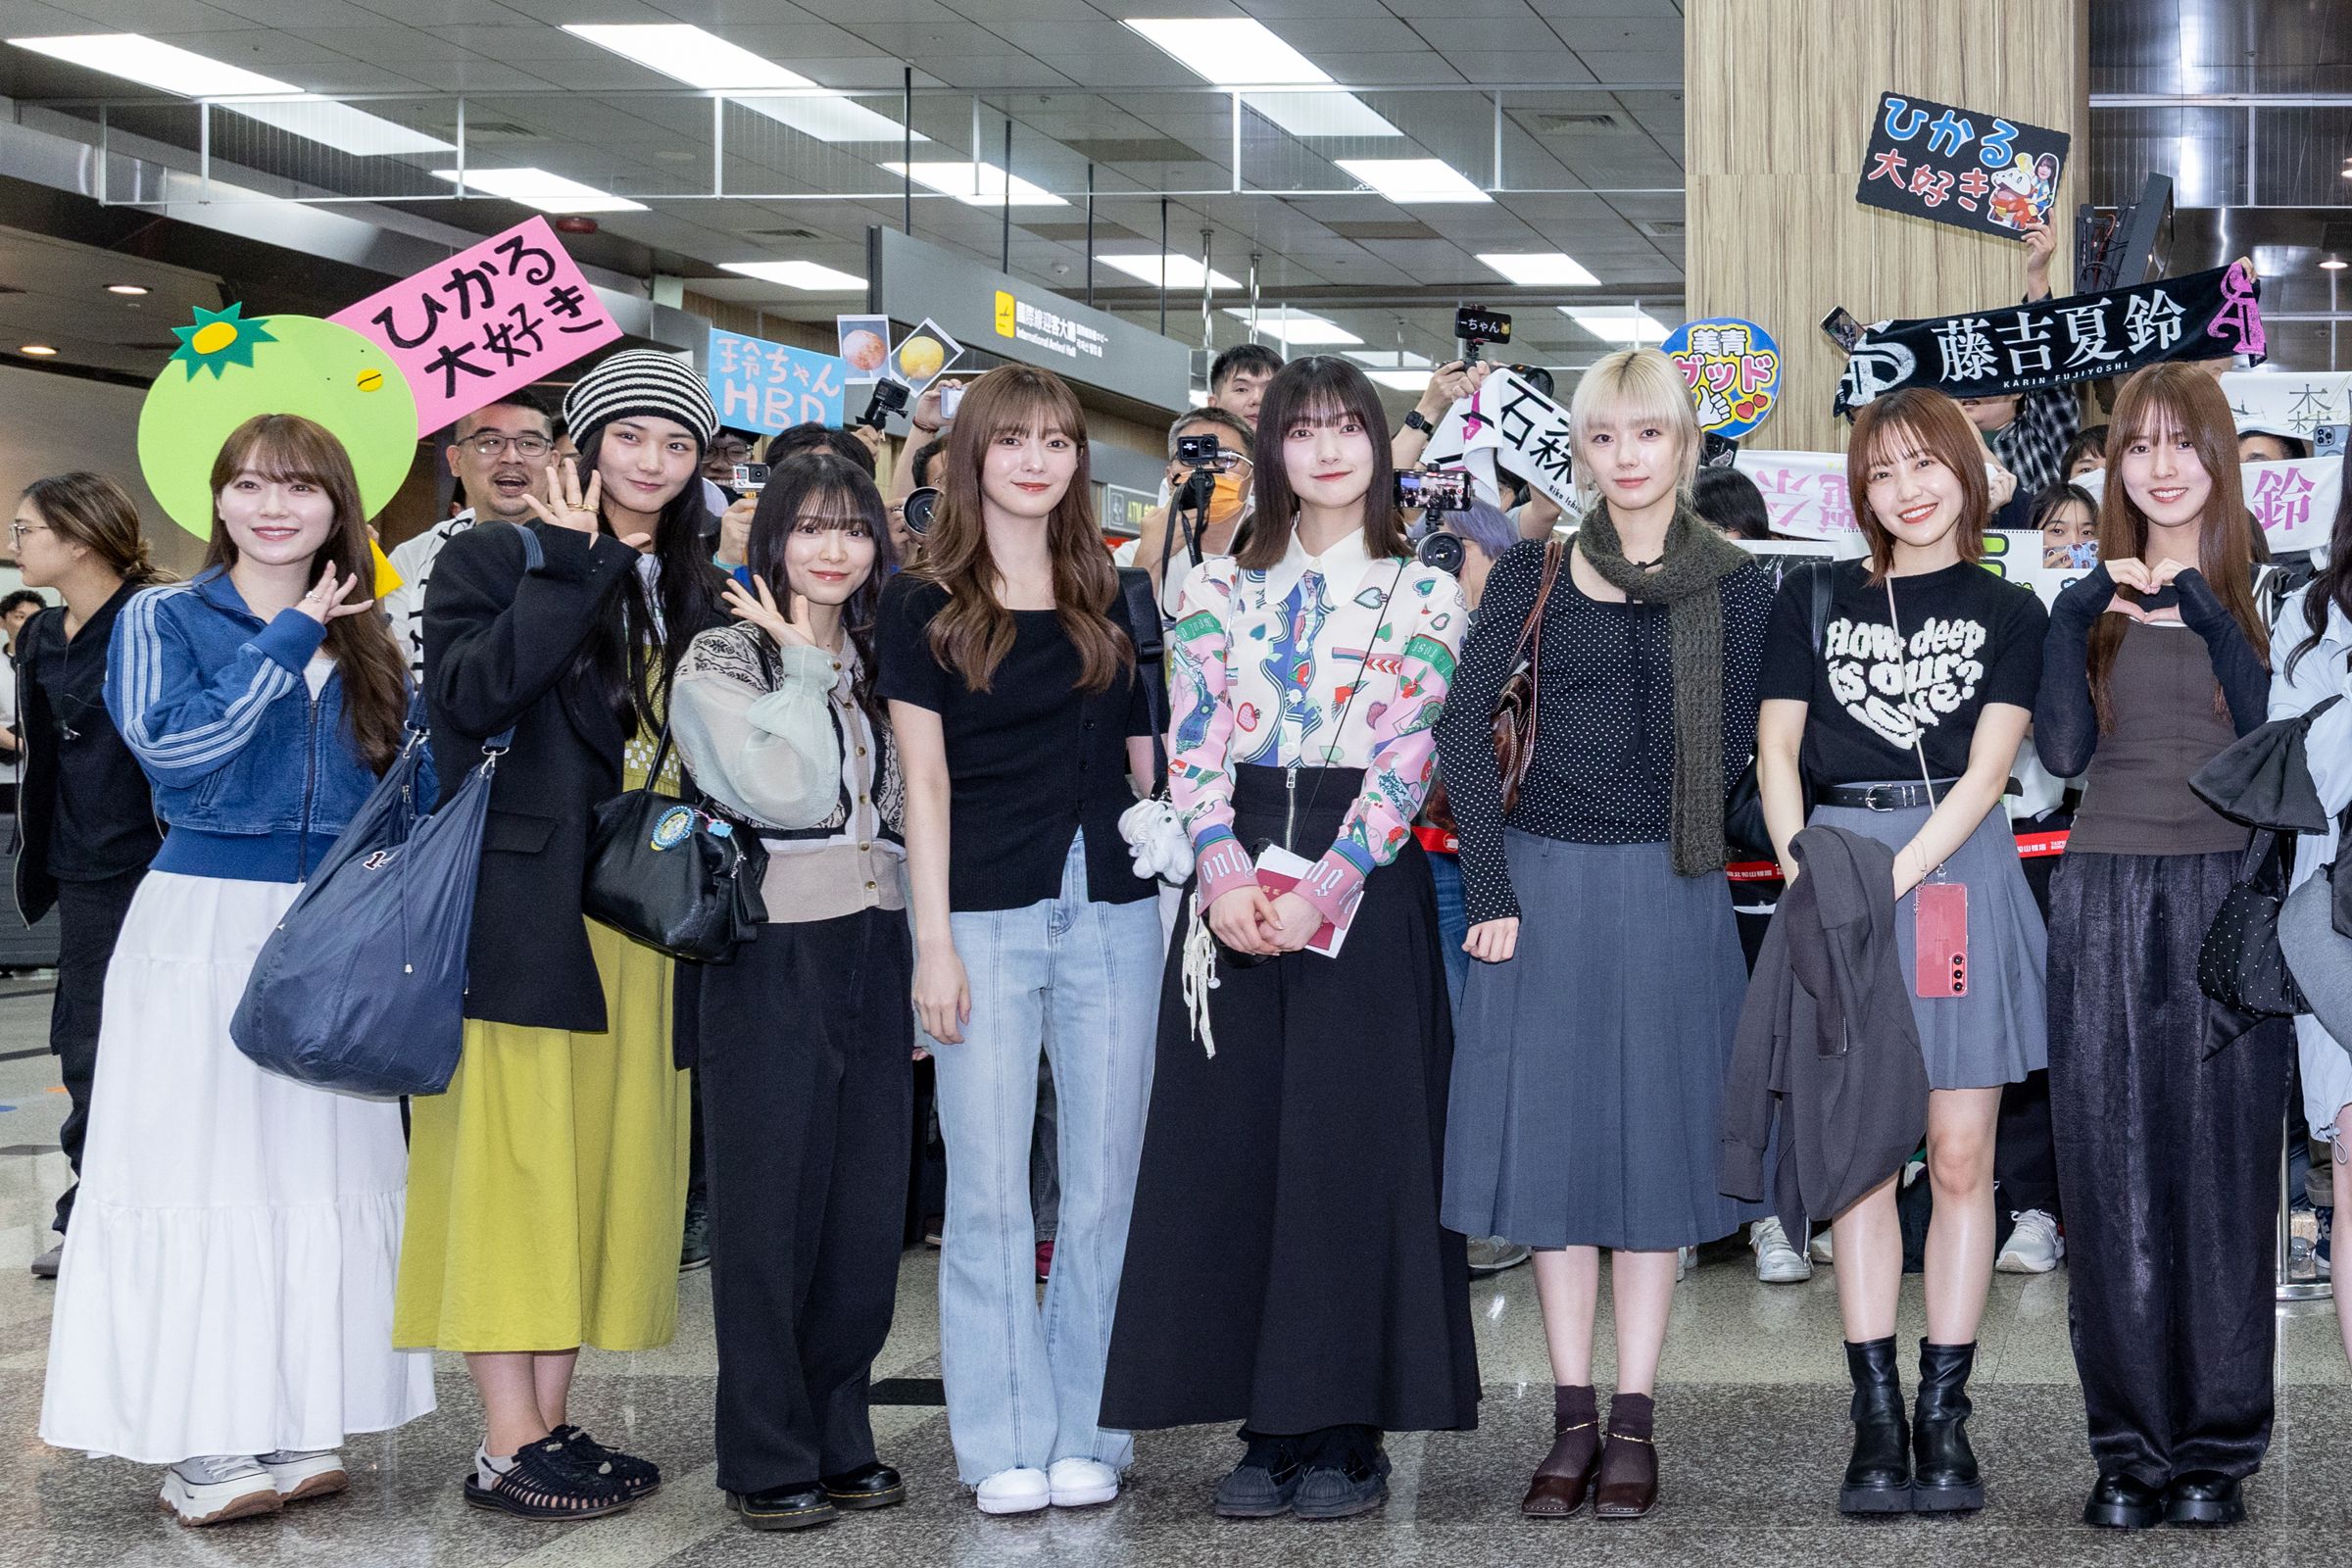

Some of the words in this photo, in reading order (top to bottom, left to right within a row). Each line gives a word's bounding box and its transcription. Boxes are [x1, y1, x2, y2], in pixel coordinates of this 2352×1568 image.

[1885, 98, 2020, 169] ひかる
[1867, 148, 1989, 212] 大好き
[371, 234, 557, 350] ひかる
[423, 285, 604, 399] 大好き
[1692, 329, 1747, 356] 美青
[1931, 289, 2186, 383] 藤吉夏鈴
[717, 338, 840, 397] 玲ちゃん
[1674, 354, 1775, 394] グッド
[2003, 376, 2046, 389] KARIN
[2054, 361, 2129, 383] FUJIYOSHI
[723, 378, 826, 429] HBD
[1910, 617, 1986, 659] deep
